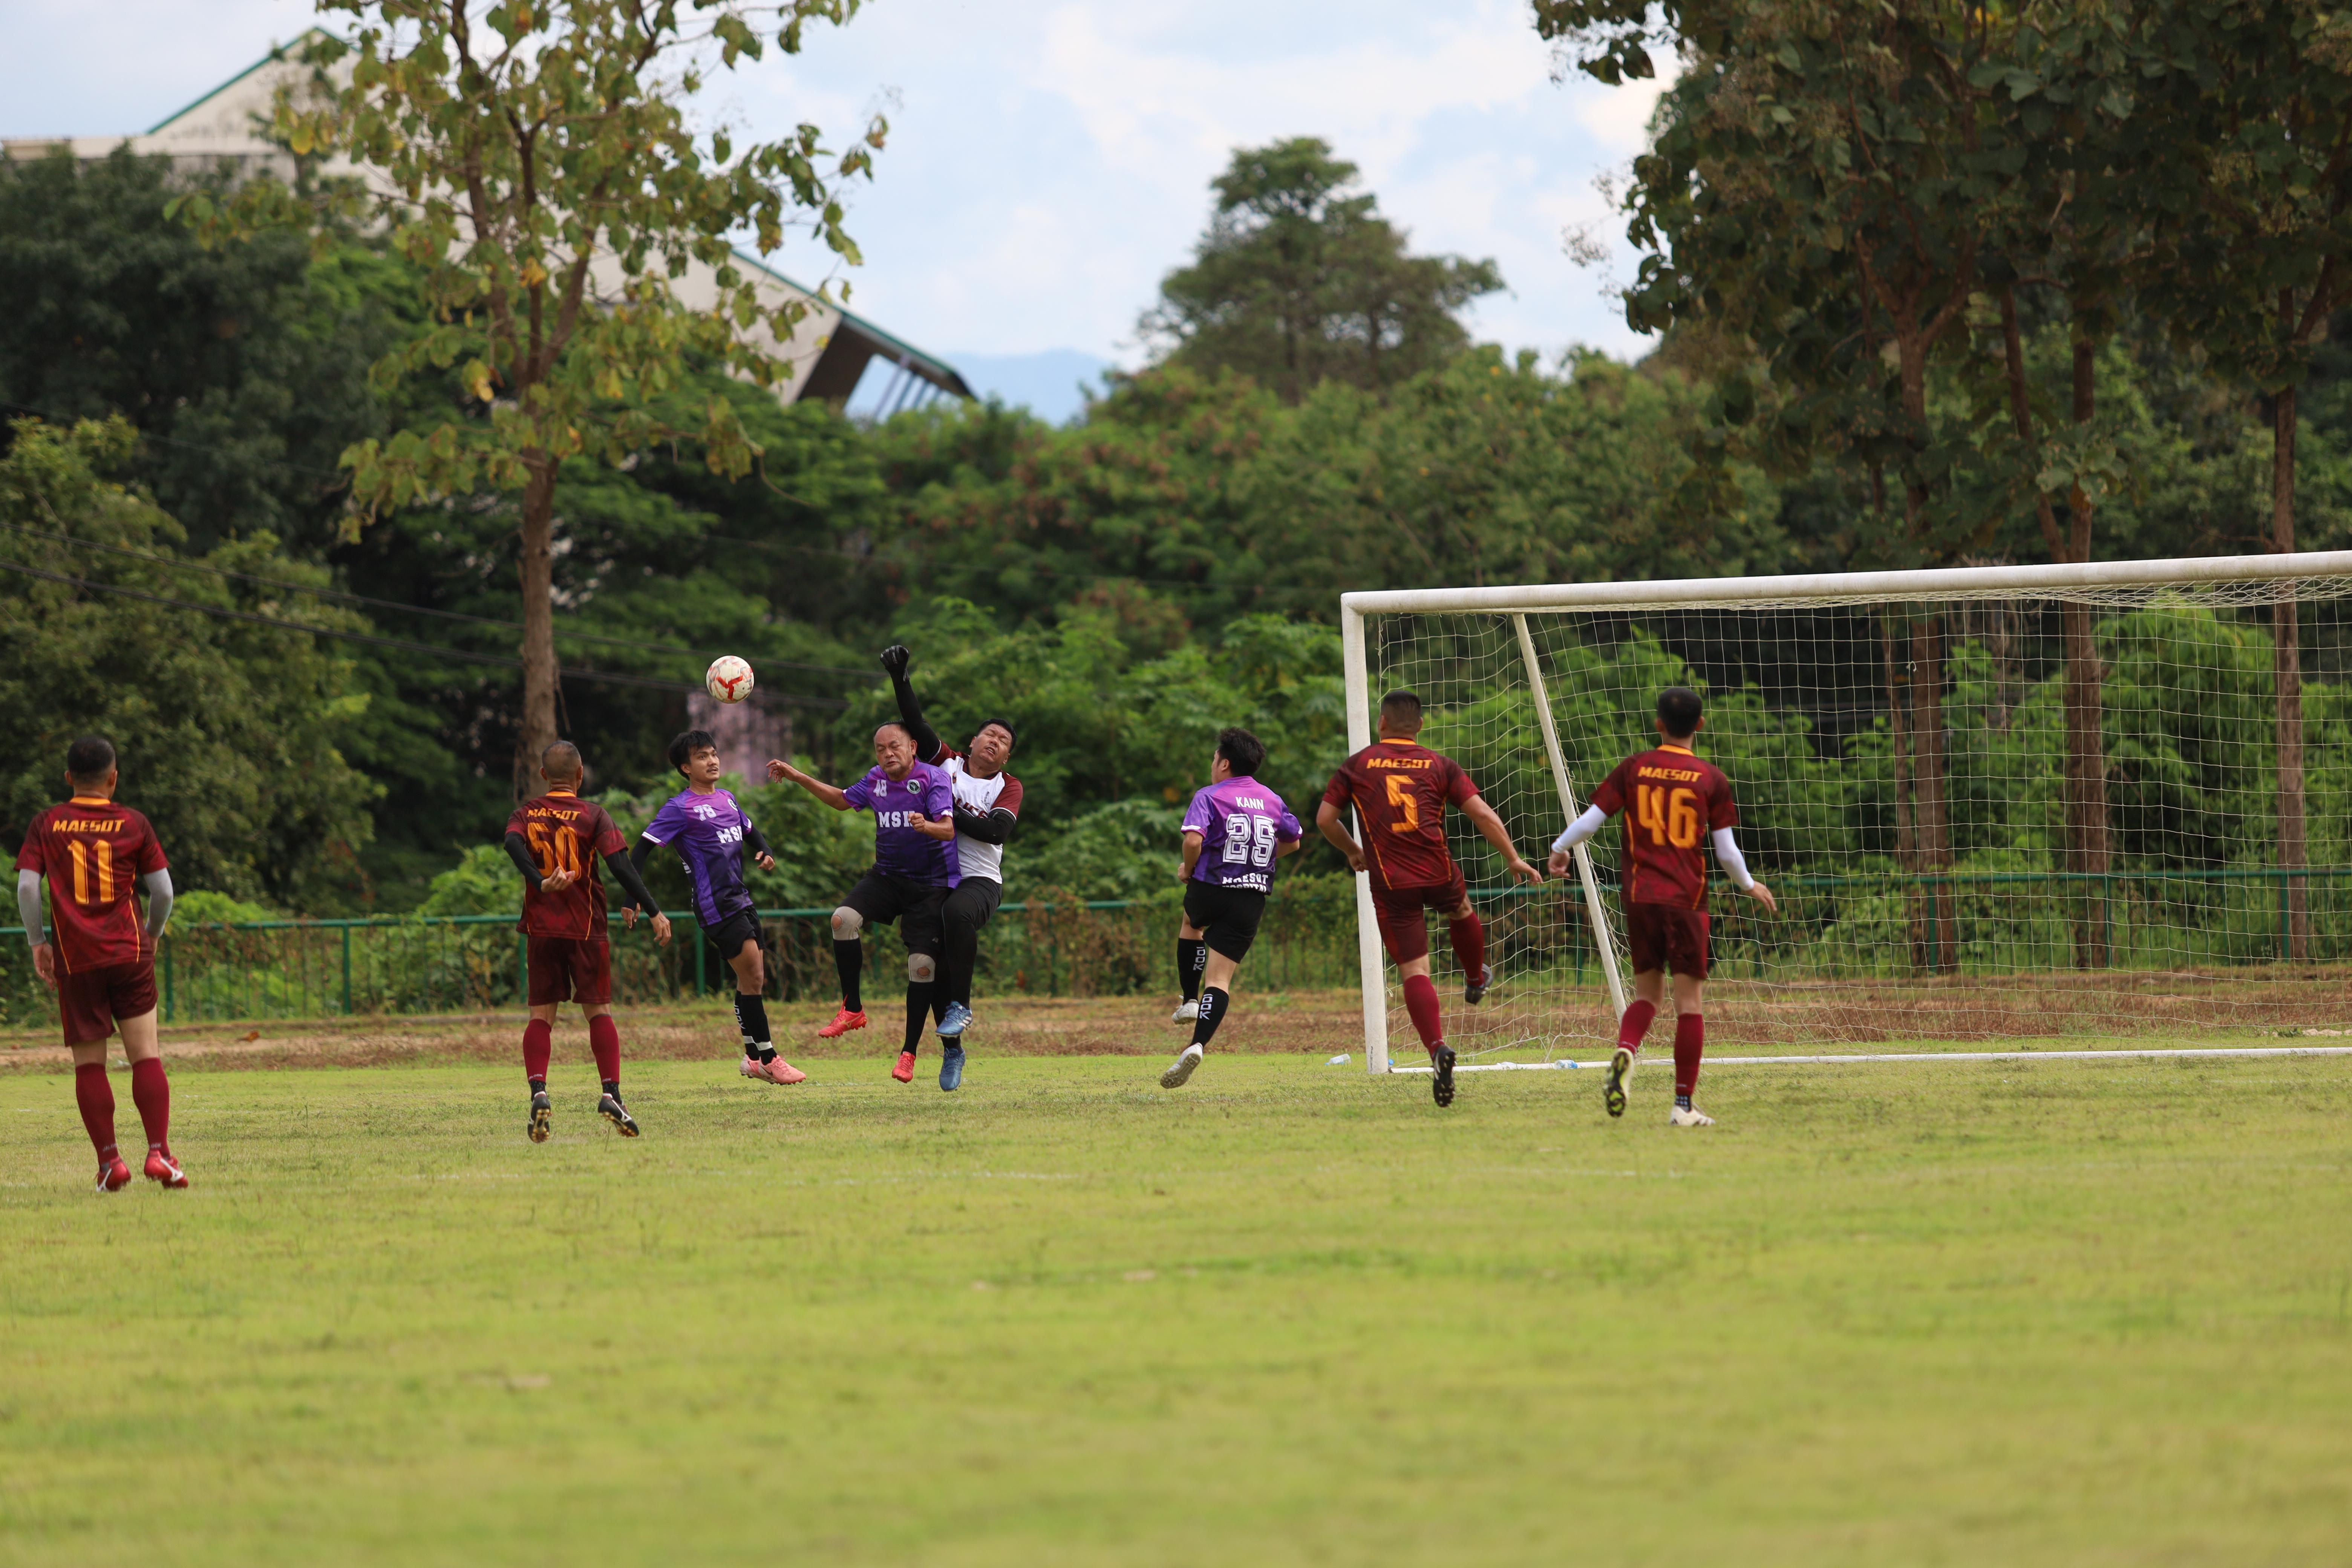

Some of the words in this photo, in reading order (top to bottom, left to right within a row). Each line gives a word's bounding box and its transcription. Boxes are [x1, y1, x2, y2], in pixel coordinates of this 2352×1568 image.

[1366, 758, 1433, 769] MAESOT
[1638, 766, 1702, 782] MAESOT
[873, 779, 887, 797] 48
[1235, 796, 1264, 810] KANN
[1386, 775, 1418, 833] 5
[527, 807, 581, 821] MAESOT
[693, 804, 717, 821] 79
[1637, 784, 1698, 849] 46
[53, 819, 125, 832] MAESOT
[1223, 813, 1275, 867] 25
[528, 822, 581, 880] 50
[67, 840, 114, 904] 11
